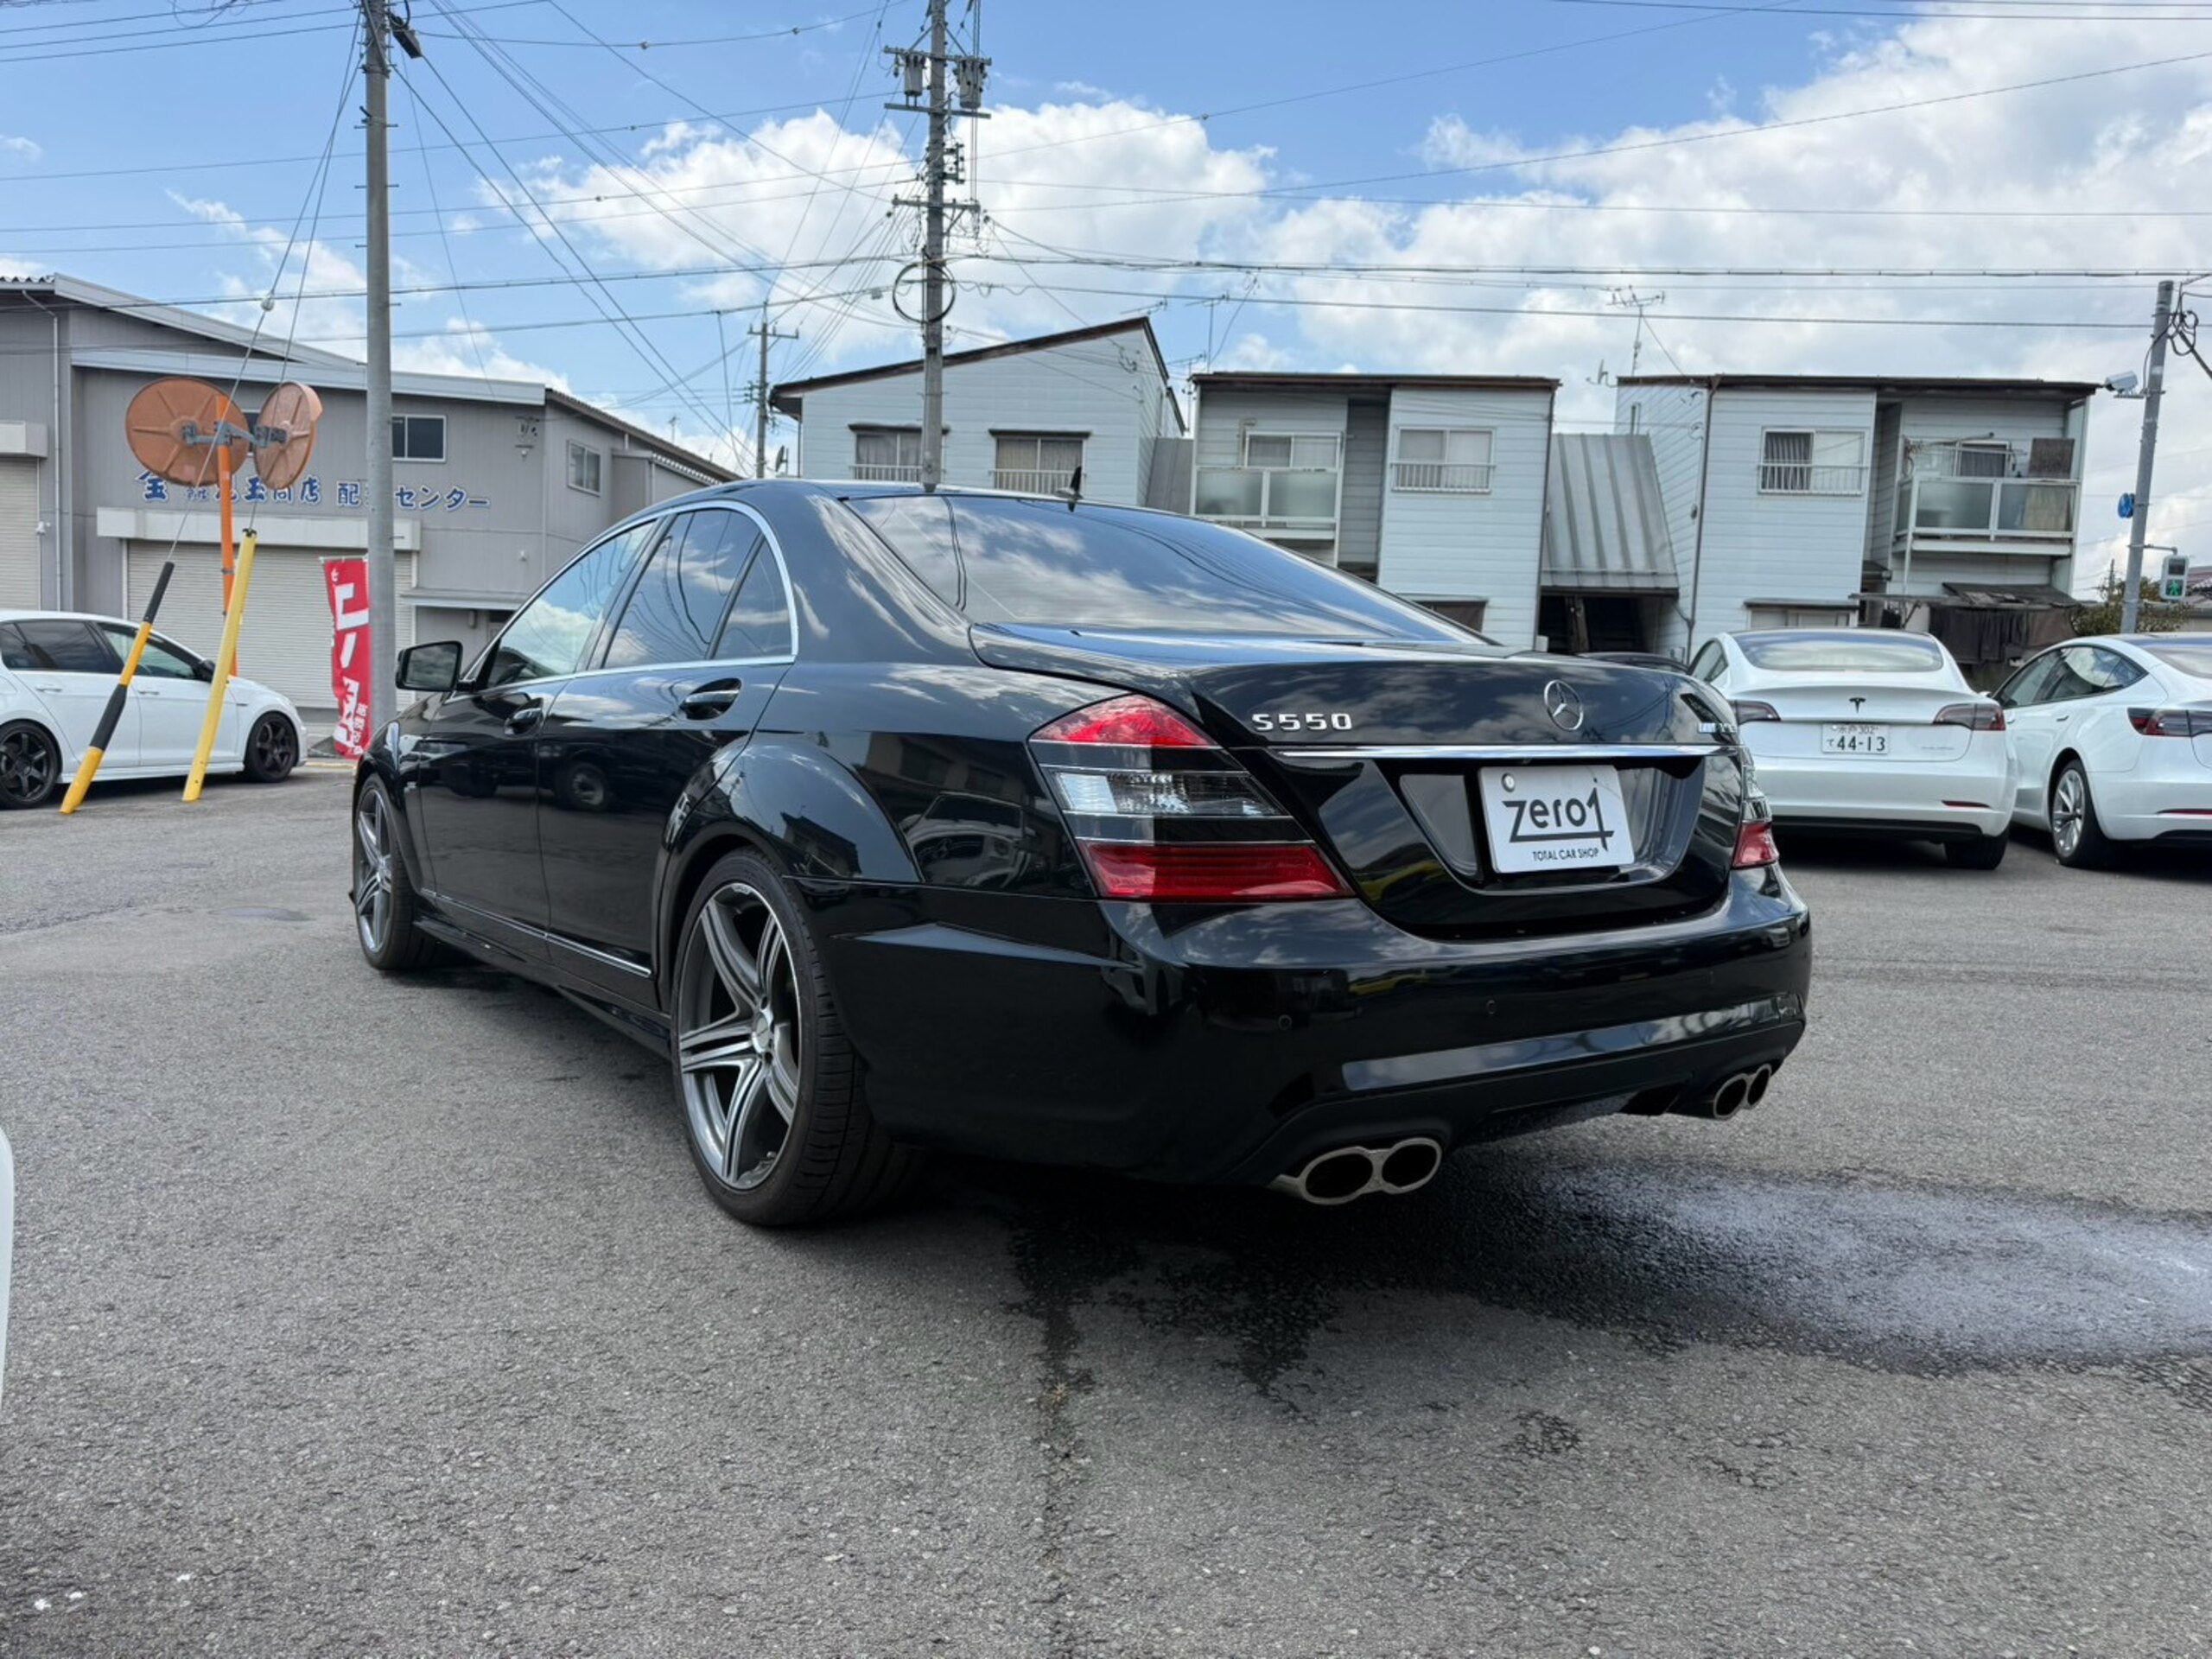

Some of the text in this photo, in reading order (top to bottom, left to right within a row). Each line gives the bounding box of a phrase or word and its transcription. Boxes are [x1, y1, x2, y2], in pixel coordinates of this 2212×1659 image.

[338, 481, 488, 509] 配センター
[1251, 713, 1352, 731] S550
[1837, 735, 1886, 753] 44-13
[1532, 847, 1599, 862] TOTAL CAR SHOP
